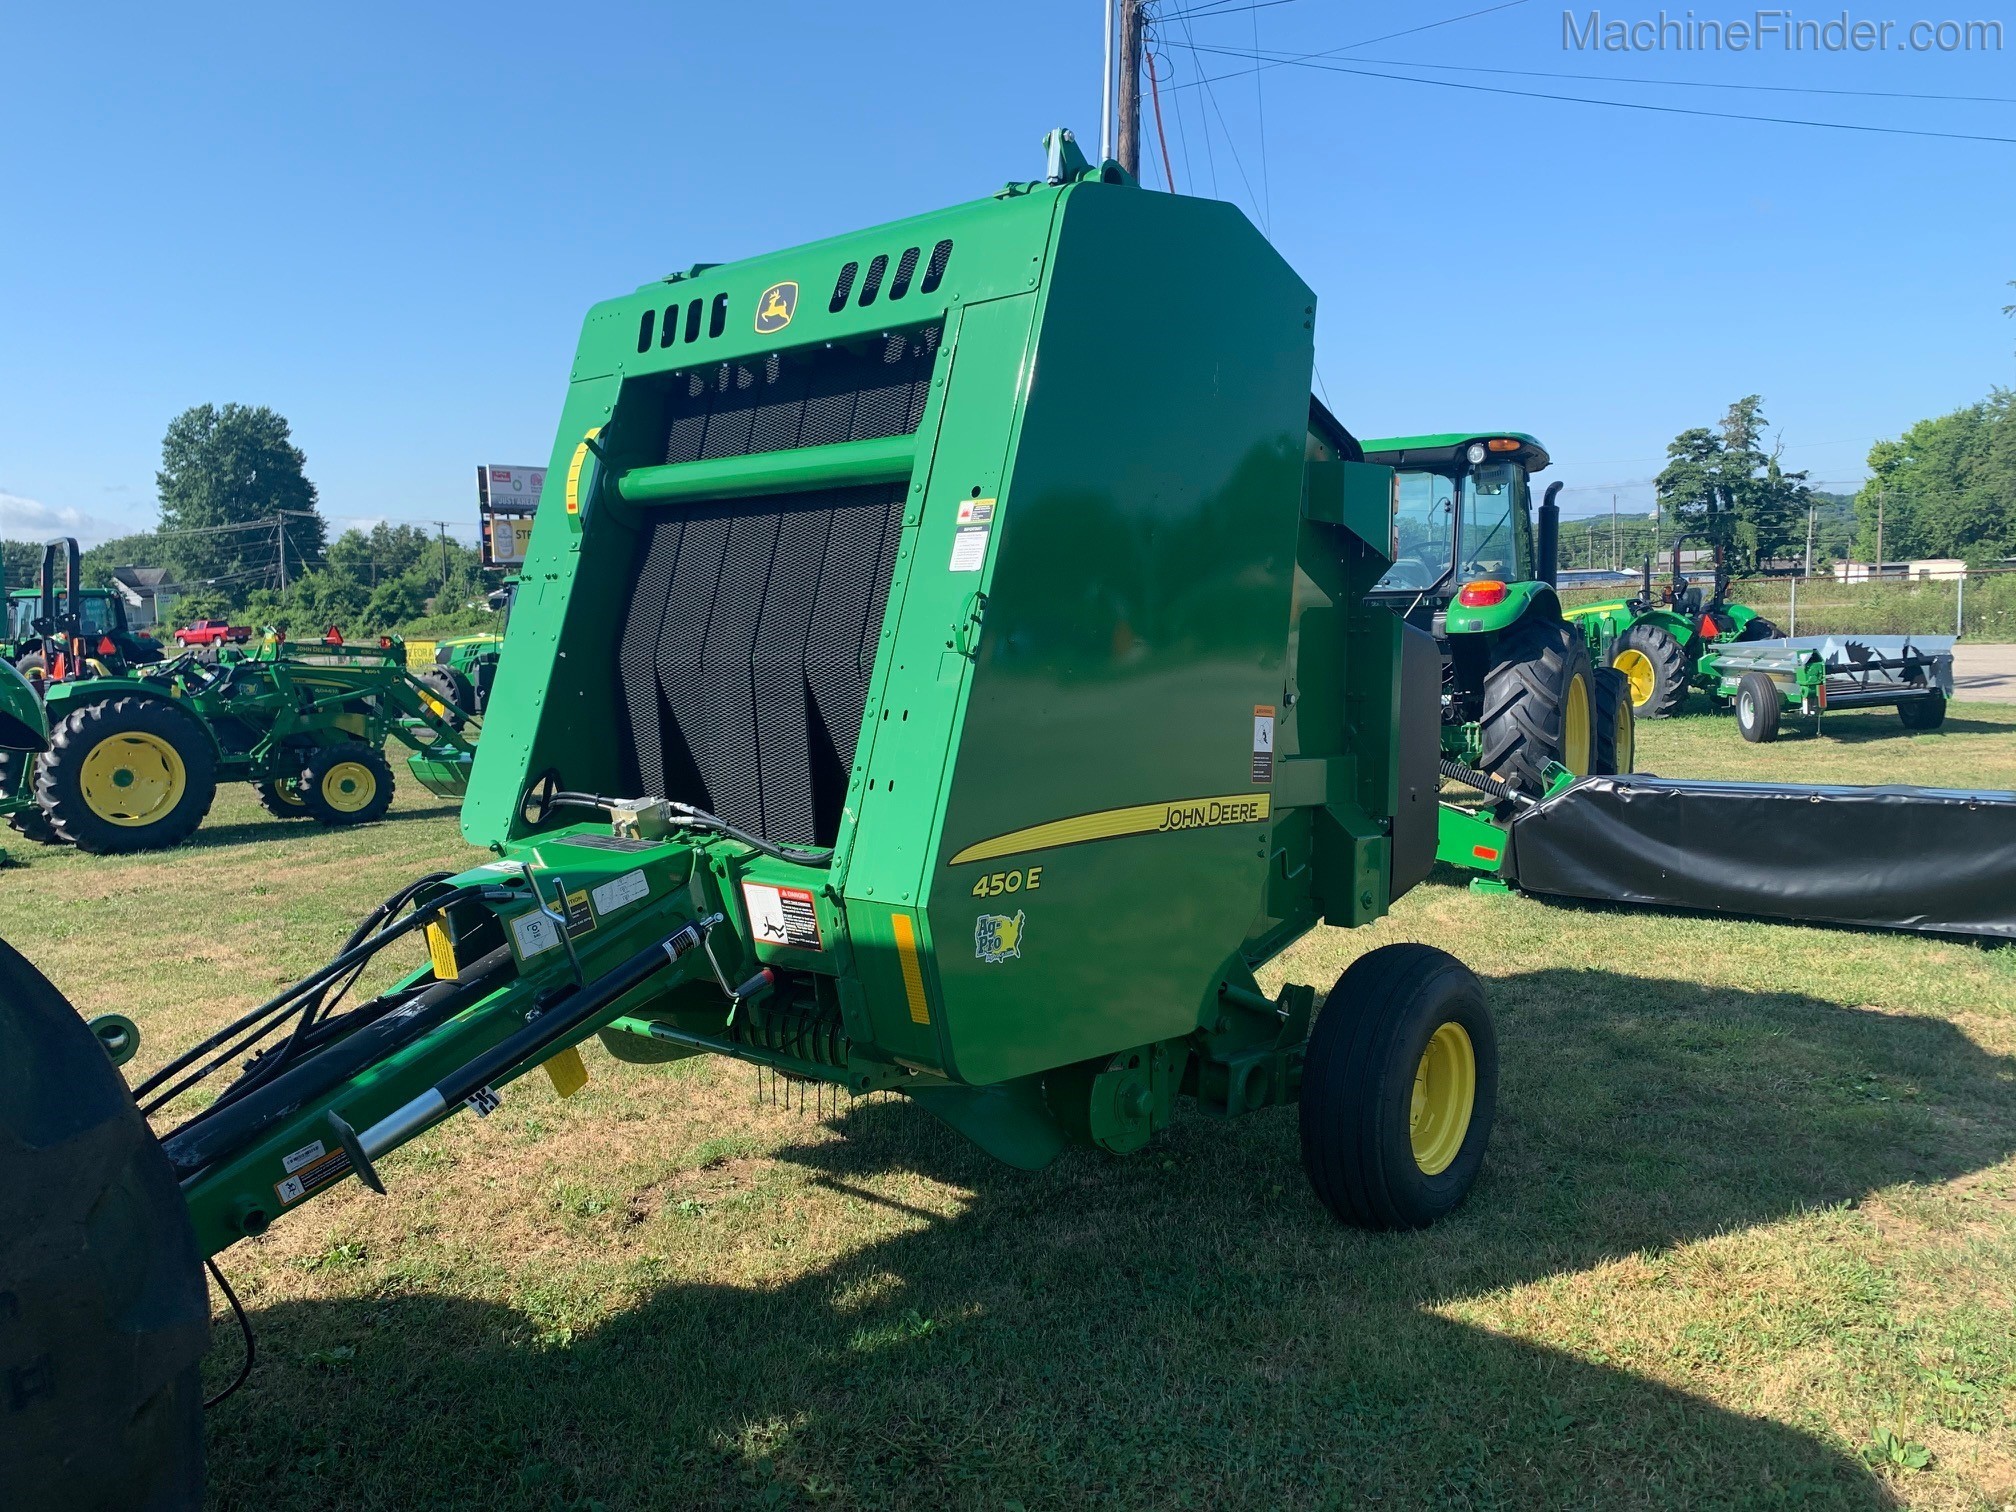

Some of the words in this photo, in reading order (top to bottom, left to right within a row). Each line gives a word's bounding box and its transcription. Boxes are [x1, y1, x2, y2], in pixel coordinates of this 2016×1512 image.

[498, 497, 515, 505] JUST
[516, 497, 538, 506] AHEAD
[1159, 807, 1205, 829] JOHN
[1209, 802, 1259, 823] DEERE
[972, 870, 1022, 898] 450
[1026, 866, 1043, 890] E
[978, 918, 1001, 938] Ag-
[978, 936, 1002, 954] Pro
